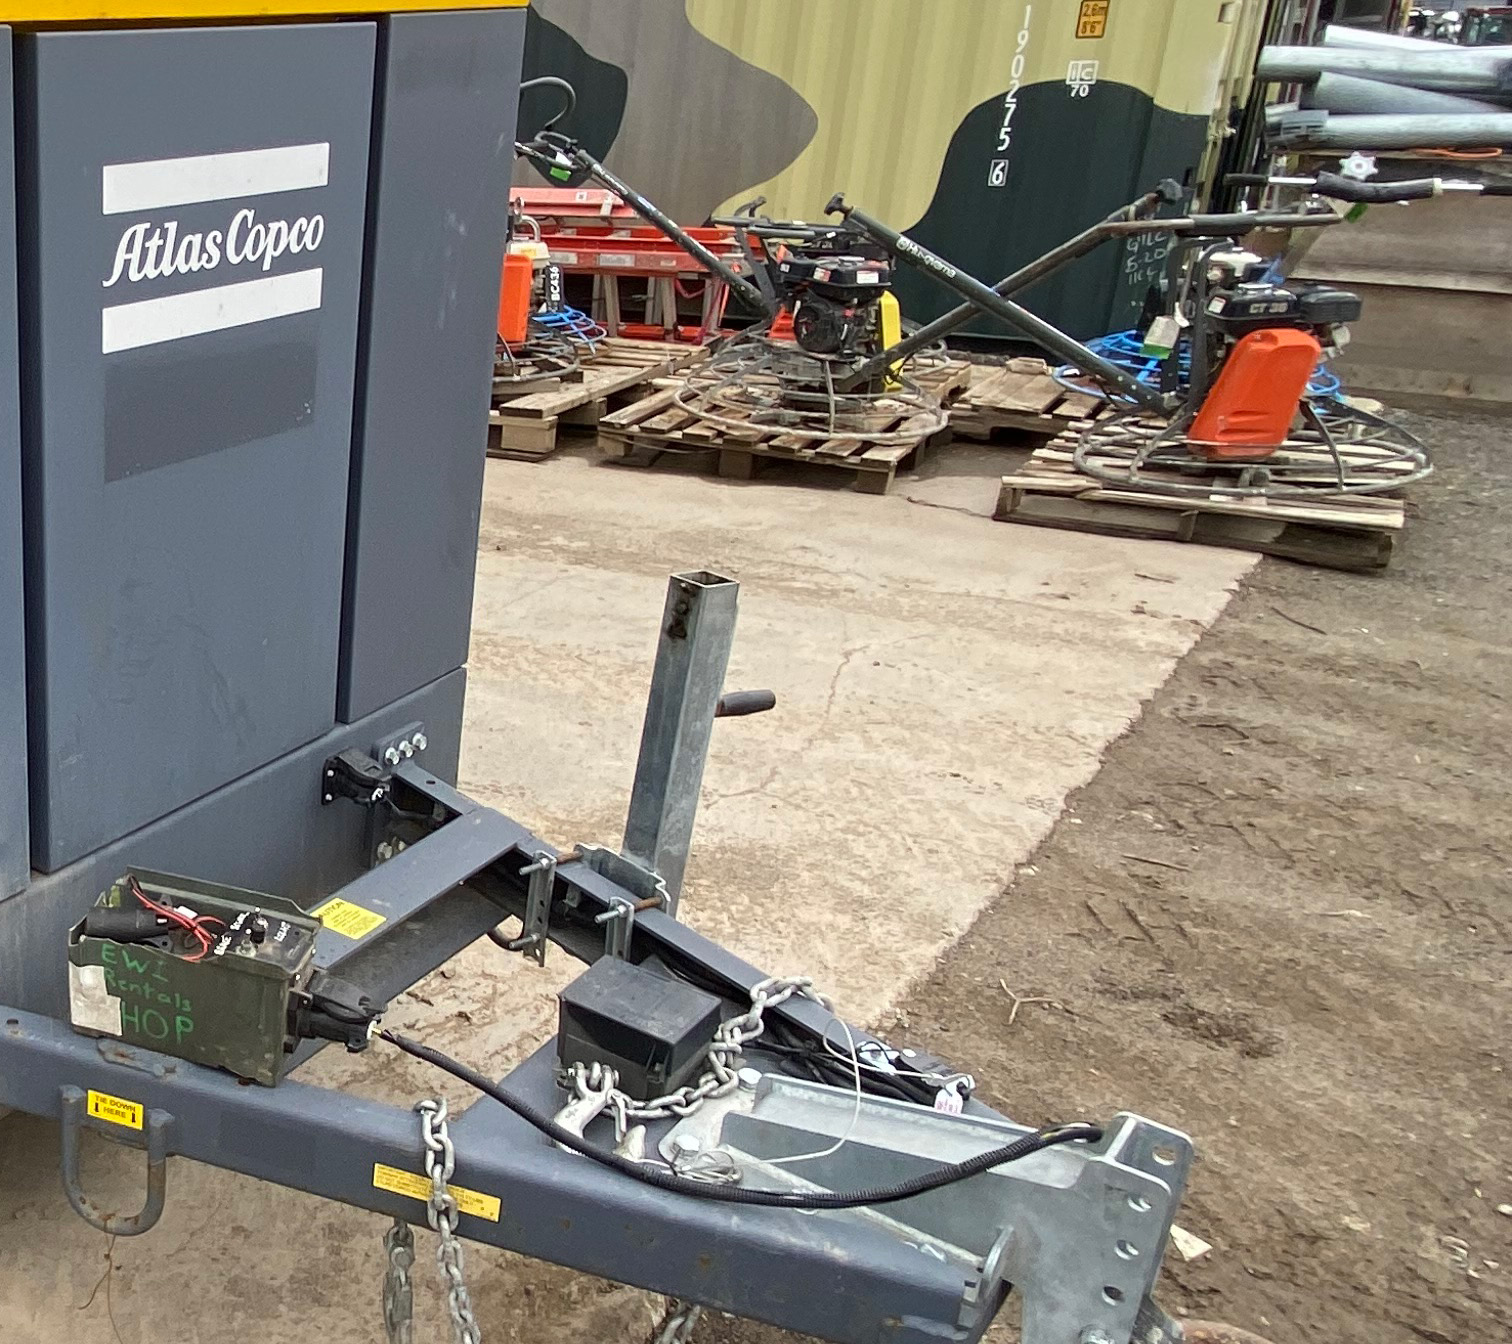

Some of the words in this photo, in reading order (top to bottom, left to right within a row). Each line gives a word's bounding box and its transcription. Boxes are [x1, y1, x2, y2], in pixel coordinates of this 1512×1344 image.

[996, 4, 1031, 152] 190275
[1070, 84, 1089, 98] 70
[991, 162, 1006, 185] 6
[101, 221, 223, 288] Atlas
[225, 208, 326, 272] Copco
[101, 943, 169, 983] EWI
[104, 968, 192, 1012] Rentals
[109, 1099, 136, 1113] DOWN
